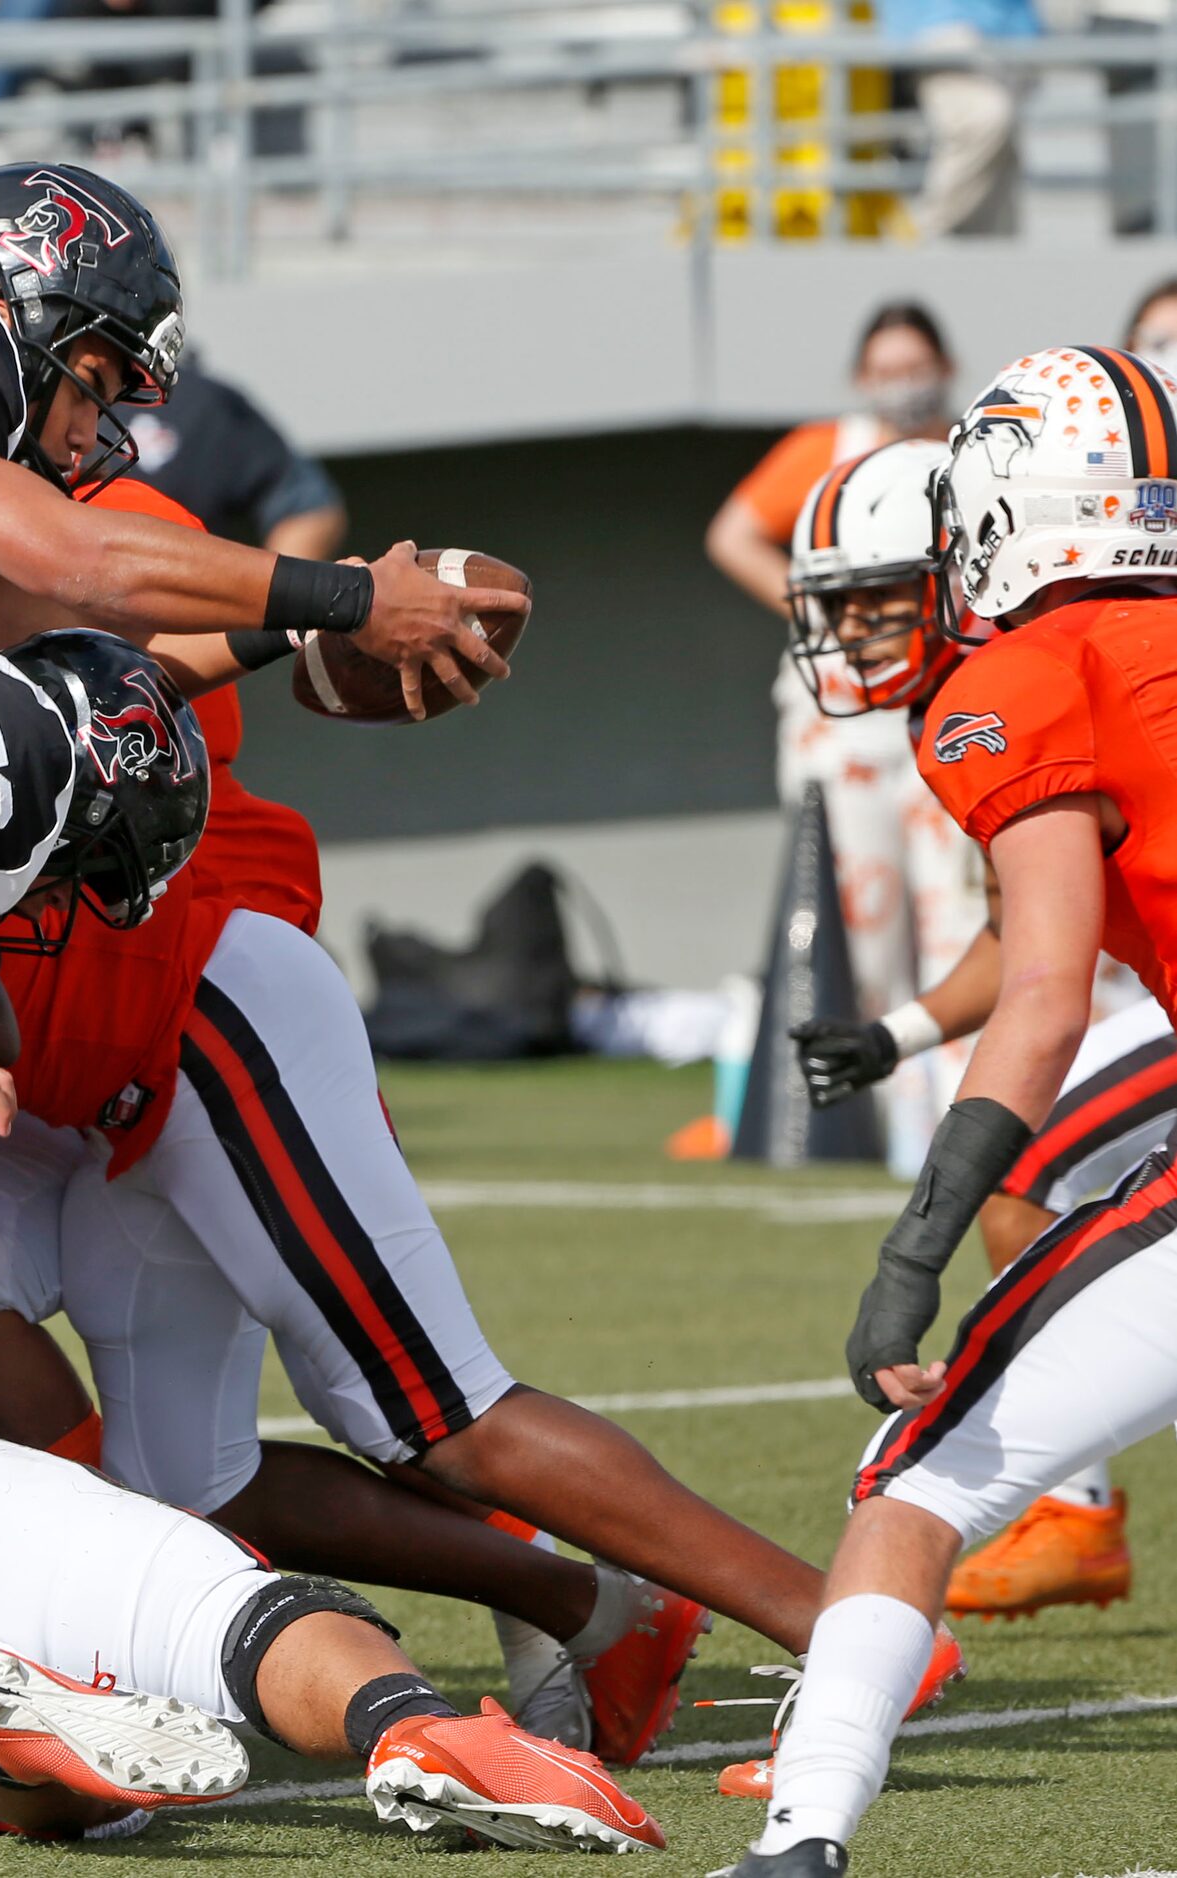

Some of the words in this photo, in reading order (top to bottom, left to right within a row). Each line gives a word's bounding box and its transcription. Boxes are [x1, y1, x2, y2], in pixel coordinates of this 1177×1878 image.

[1135, 484, 1176, 509] 100
[1111, 543, 1177, 567] schu
[386, 1744, 426, 1761] VAPOR
